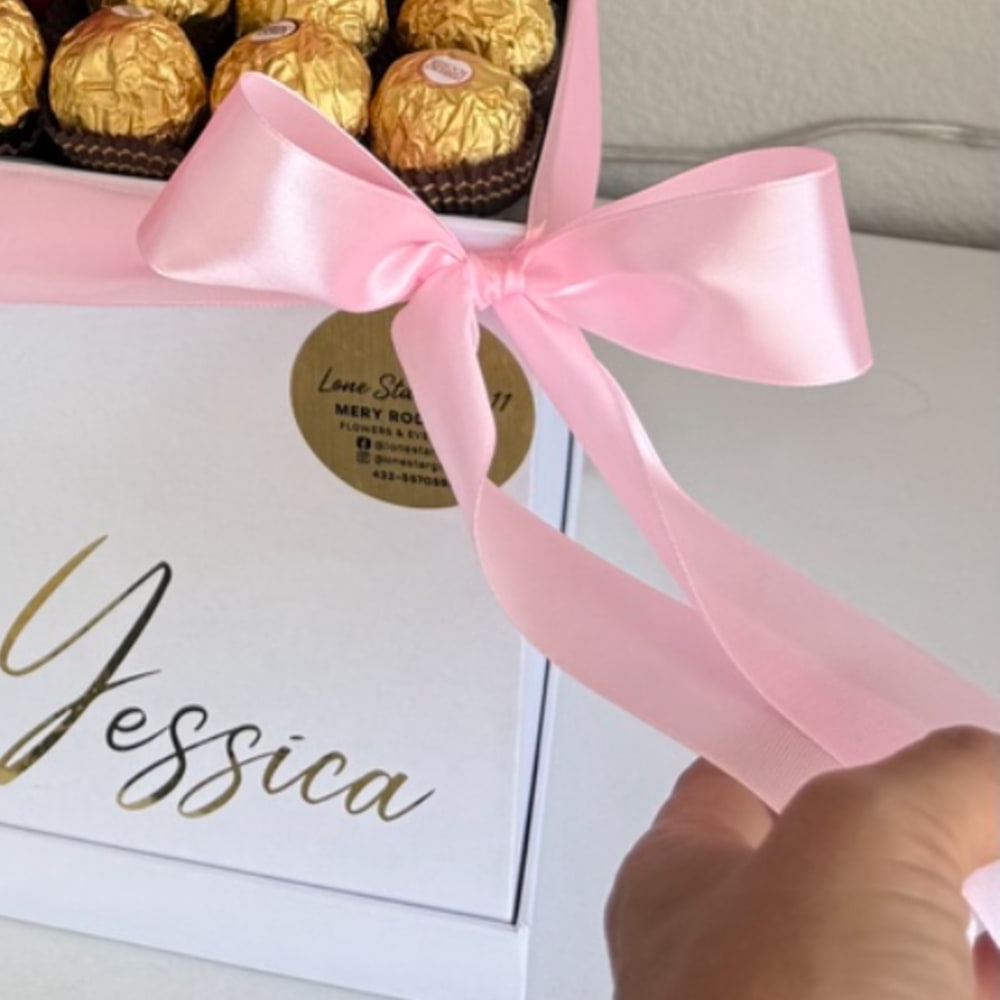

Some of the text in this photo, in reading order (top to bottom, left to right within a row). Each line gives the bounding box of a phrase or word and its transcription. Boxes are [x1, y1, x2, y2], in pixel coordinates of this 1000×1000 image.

[318, 367, 369, 394] Lone
[373, 373, 413, 400] Sta
[335, 403, 382, 421] MERY
